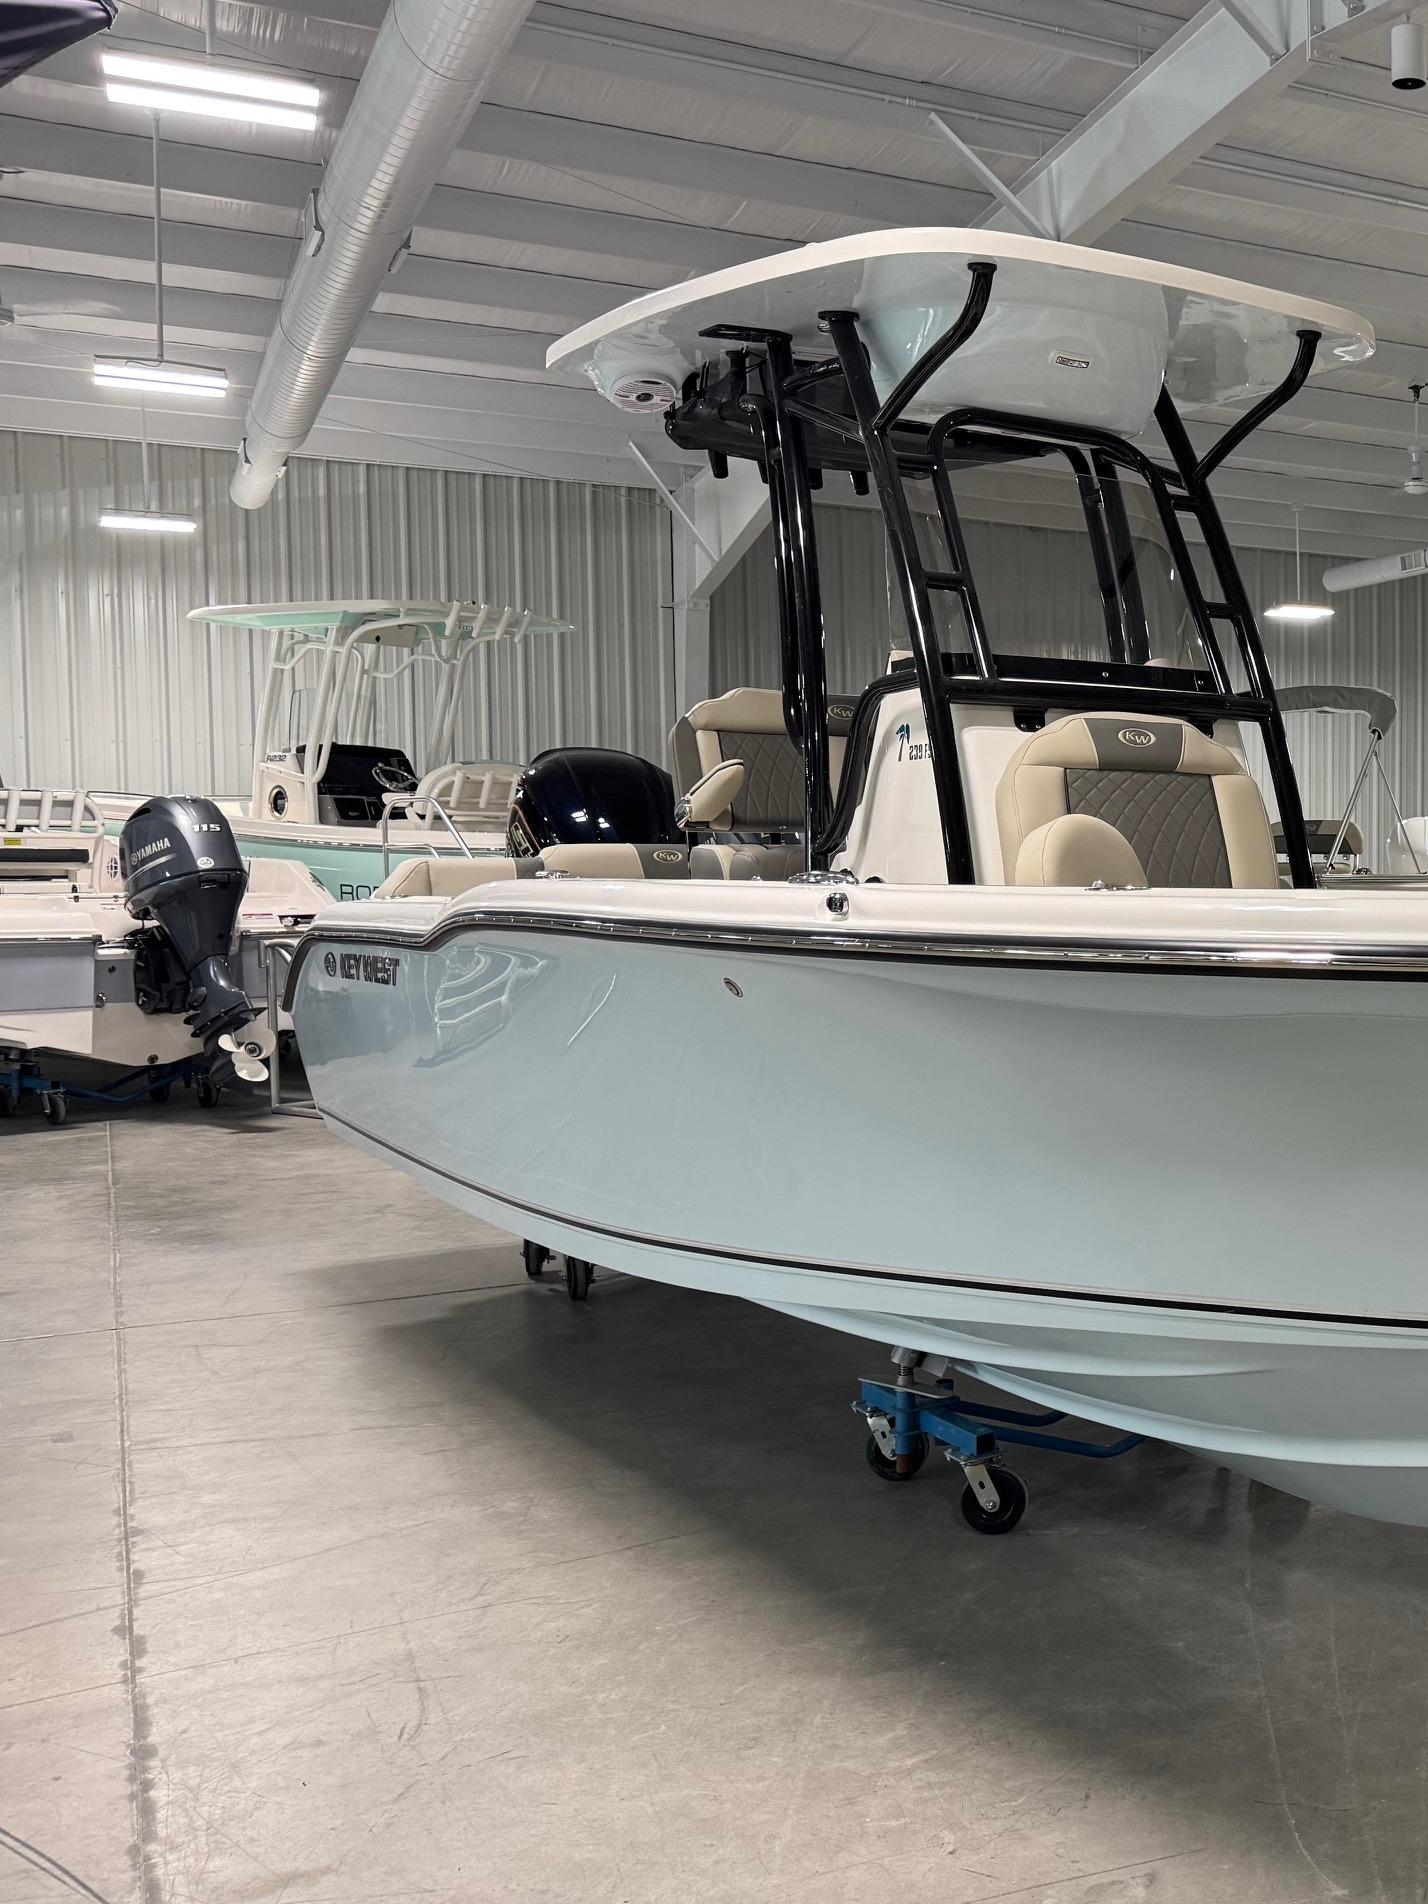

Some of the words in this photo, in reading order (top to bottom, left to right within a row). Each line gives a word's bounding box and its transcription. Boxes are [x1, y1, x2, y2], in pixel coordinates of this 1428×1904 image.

[832, 706, 854, 718] KW
[1123, 730, 1151, 745] KW
[192, 823, 221, 832] 115
[137, 837, 171, 861] YAMAHA
[657, 851, 679, 862] KW
[340, 953, 362, 980] KEY
[362, 954, 400, 986] WEST
